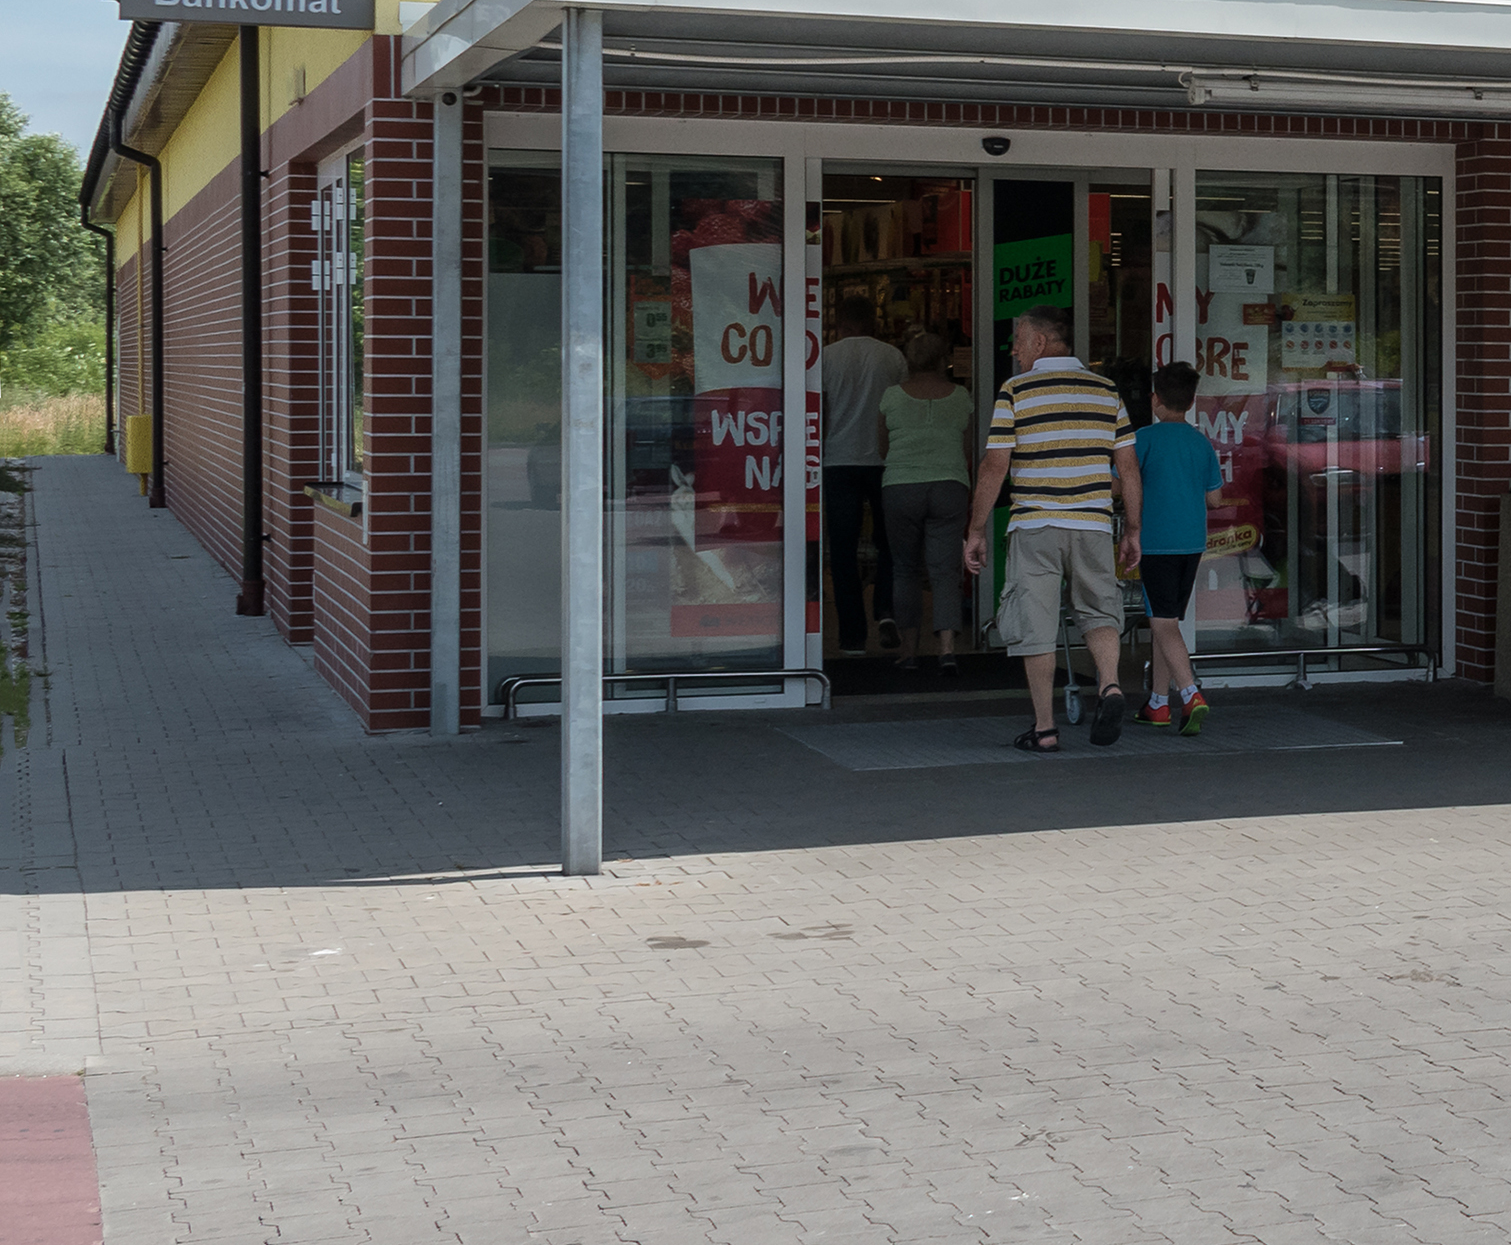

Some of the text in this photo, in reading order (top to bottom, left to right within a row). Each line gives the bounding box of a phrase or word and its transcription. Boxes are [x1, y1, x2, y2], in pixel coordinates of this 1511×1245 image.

[999, 256, 1057, 286] DUŻE
[999, 278, 1067, 303] RABATY
[1206, 530, 1252, 549] dronka
